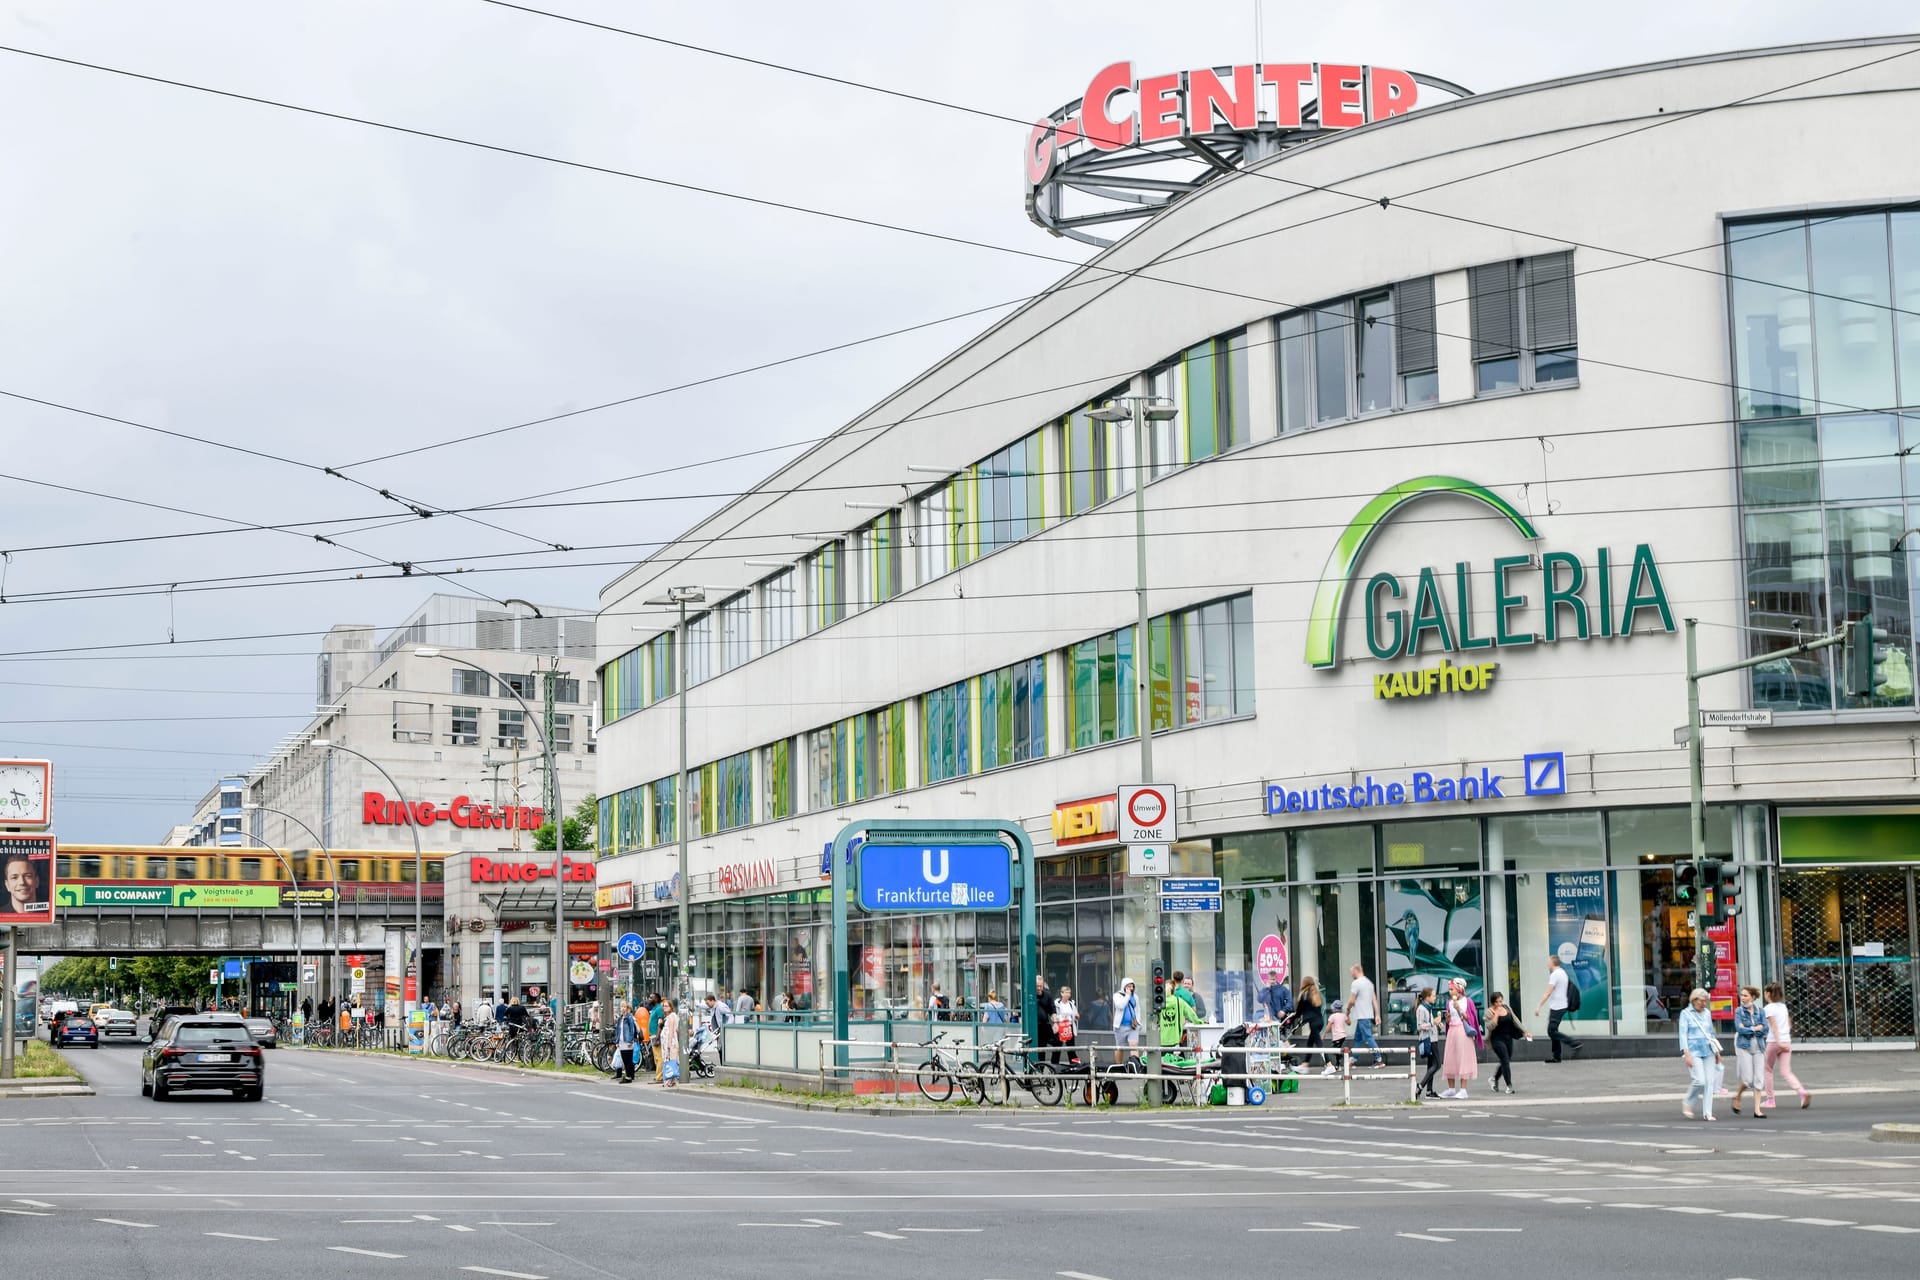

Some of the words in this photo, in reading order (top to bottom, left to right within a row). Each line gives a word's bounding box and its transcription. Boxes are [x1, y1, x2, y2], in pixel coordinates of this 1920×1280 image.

[1364, 543, 1678, 661] GALERIA
[1267, 775, 1406, 815] Deutsche
[1412, 767, 1505, 803] Bank
[1133, 804, 1161, 812] Umwelt
[1133, 829, 1163, 840] ZONE
[923, 849, 949, 884] U
[1142, 864, 1157, 872] frei
[718, 857, 776, 895] ROSSMANN
[1554, 875, 1600, 886] SVICES
[95, 891, 112, 899] BIO
[877, 887, 954, 903] Frankfurte
[1555, 888, 1601, 897] ERLEBEN!
[1260, 954, 1283, 967] 50%
